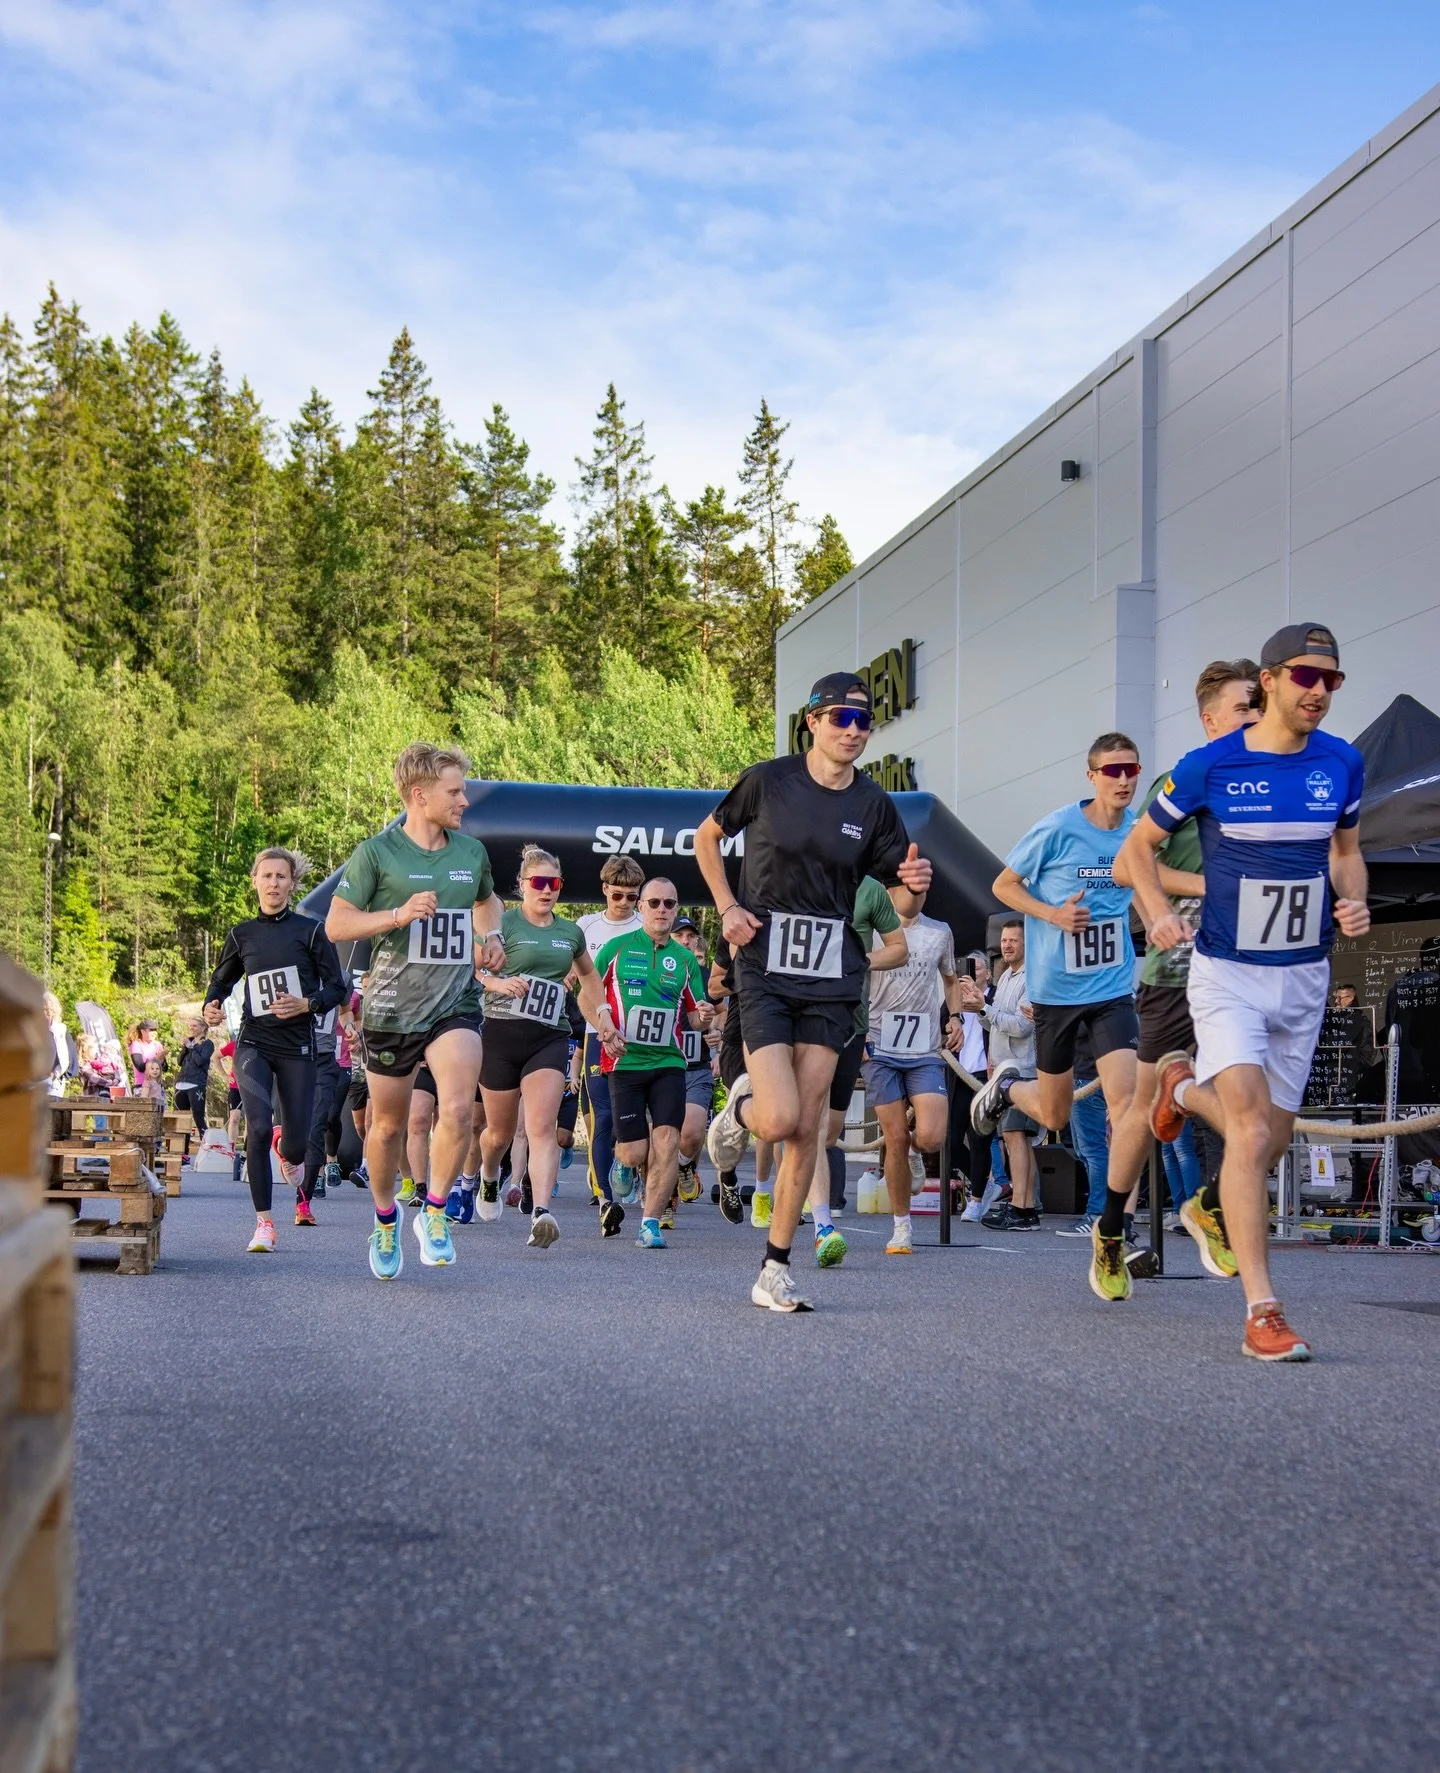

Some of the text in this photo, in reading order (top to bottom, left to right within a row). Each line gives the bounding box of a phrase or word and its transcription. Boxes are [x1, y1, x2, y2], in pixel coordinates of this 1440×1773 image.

[592, 825, 745, 857] SALOM
[1079, 868, 1113, 877] DEMIDE
[1086, 881, 1099, 889] DU
[1260, 885, 1310, 944] 78
[419, 912, 465, 960] 195
[779, 917, 833, 972] 197
[1072, 922, 1116, 968] 196
[258, 971, 288, 1010] 98
[520, 979, 559, 1020] 198
[636, 1009, 666, 1043] 69
[893, 1015, 921, 1048] 77
[685, 1033, 696, 1059] 0
